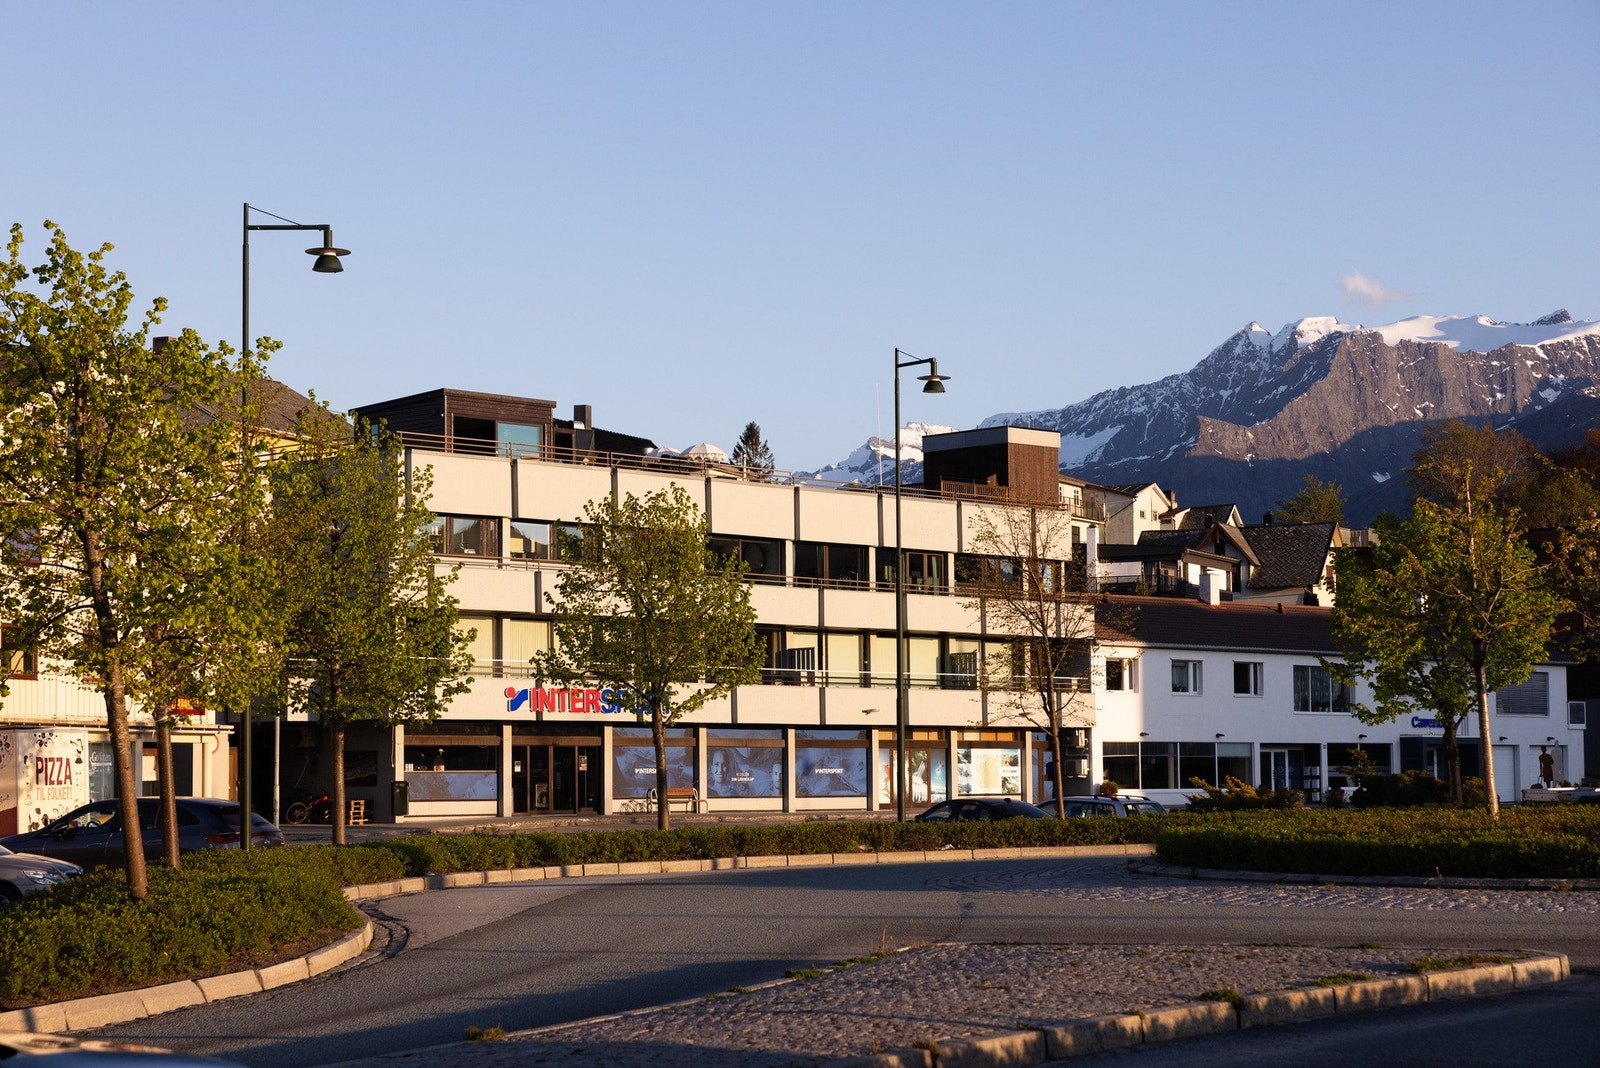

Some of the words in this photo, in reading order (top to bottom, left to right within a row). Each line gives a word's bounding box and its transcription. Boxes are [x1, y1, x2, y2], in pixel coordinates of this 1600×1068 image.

[530, 687, 671, 715] INTERSP
[35, 757, 72, 785] PIZZA
[36, 787, 46, 800] TIL
[47, 787, 72, 800] FOLKET!
